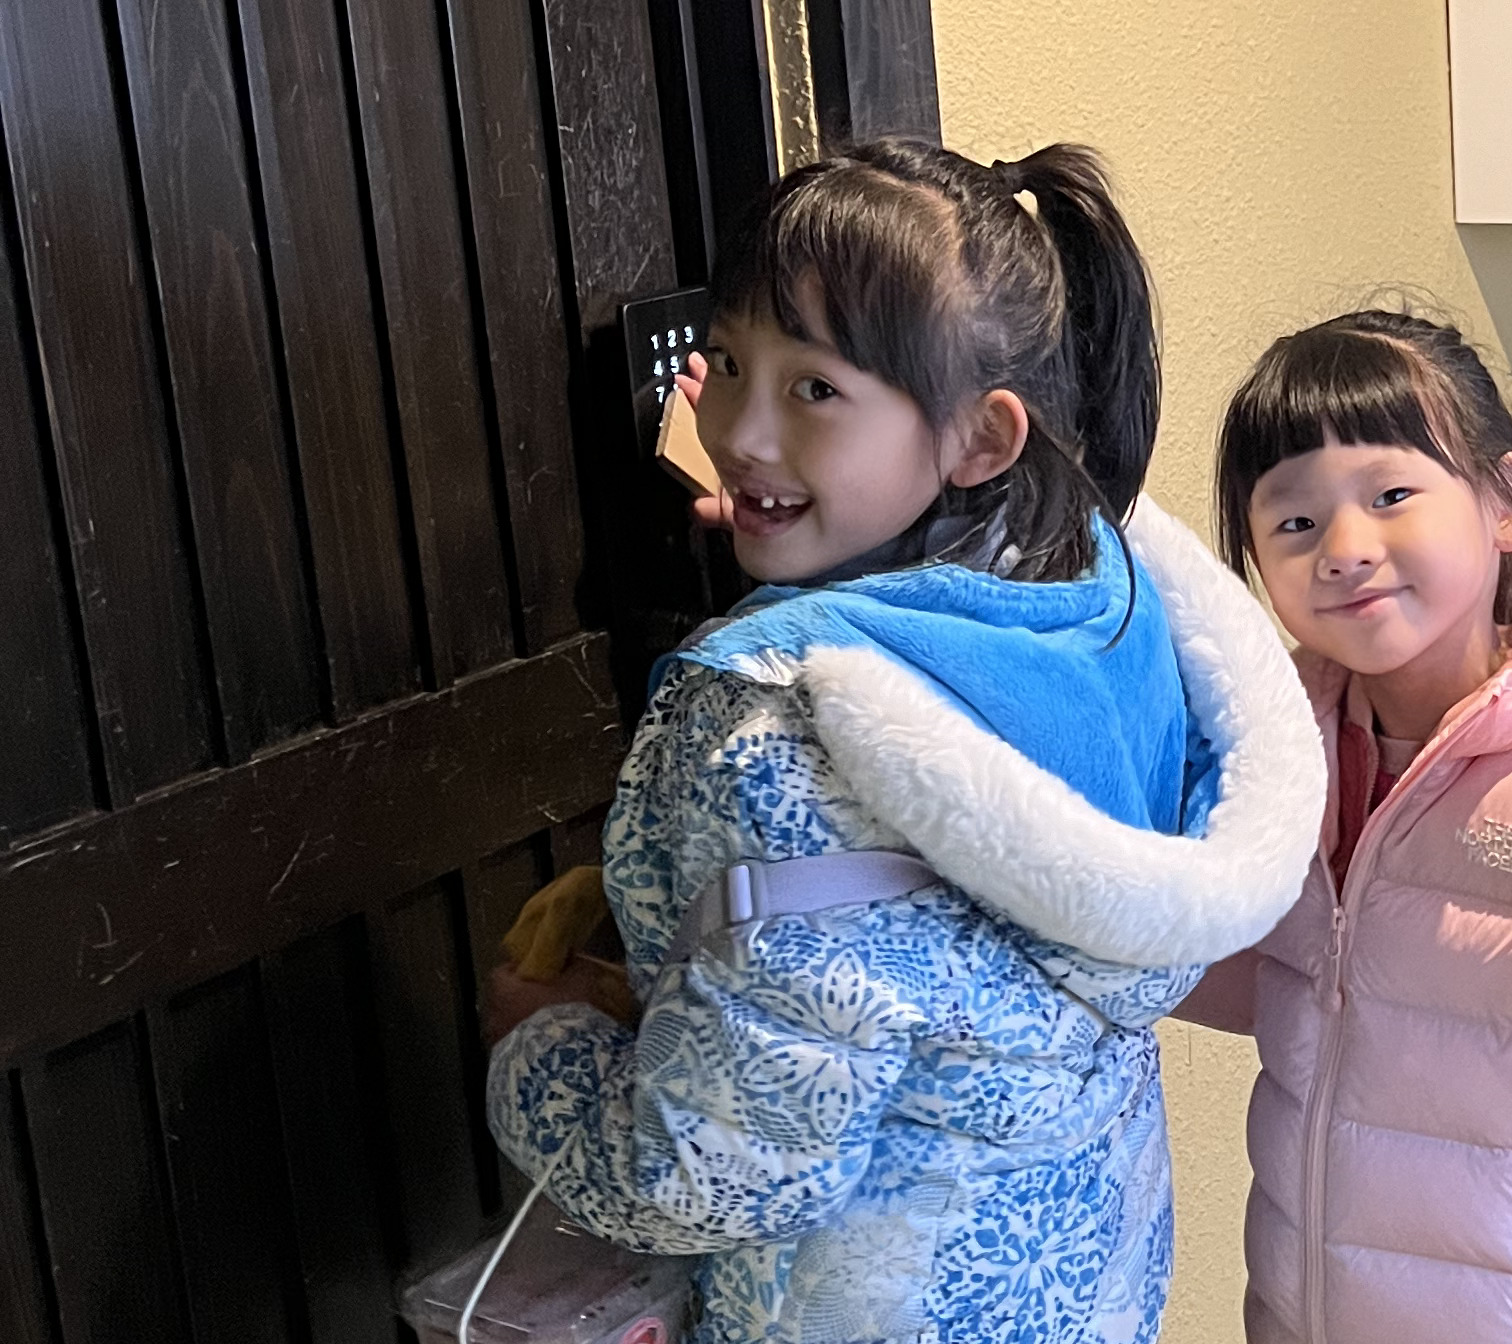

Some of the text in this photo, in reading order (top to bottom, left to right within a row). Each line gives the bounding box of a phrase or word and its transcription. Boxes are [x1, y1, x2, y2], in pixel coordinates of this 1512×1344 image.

[651, 325, 694, 350] 1 2 3
[653, 356, 680, 376] 4 5
[656, 386, 665, 403] 7
